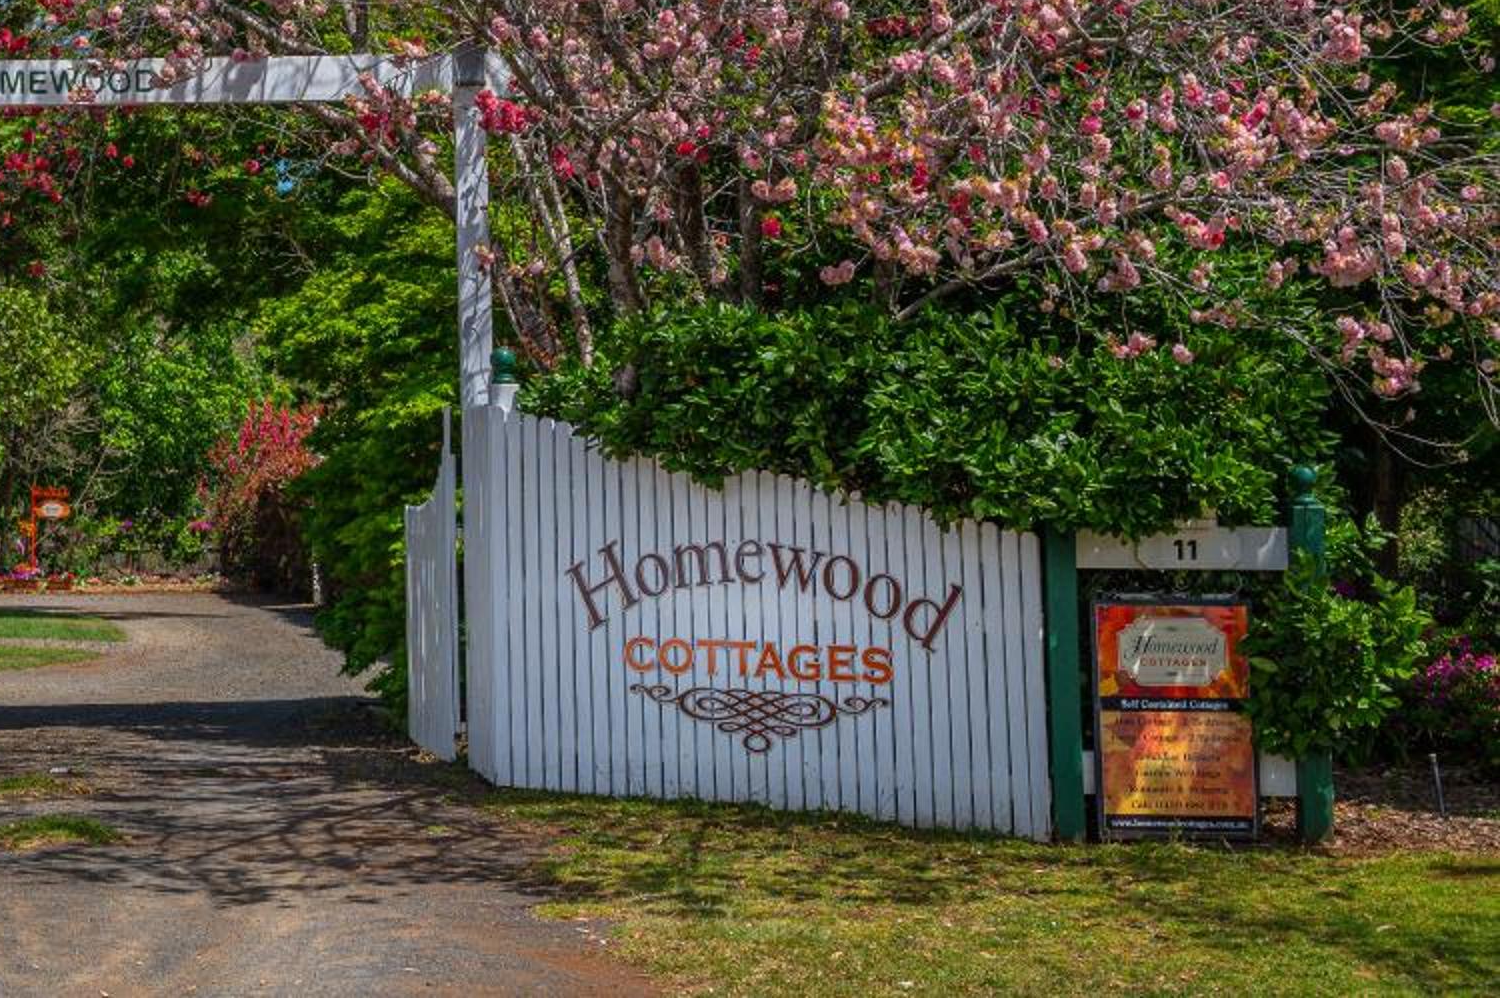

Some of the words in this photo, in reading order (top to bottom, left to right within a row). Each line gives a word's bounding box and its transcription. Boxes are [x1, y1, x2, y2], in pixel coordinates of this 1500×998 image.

[1173, 539, 1198, 561] 11
[566, 537, 964, 654] Homewood
[1124, 634, 1220, 659] Homewood
[622, 636, 896, 686] COTTAGES
[1140, 657, 1207, 667] COTTAGES
